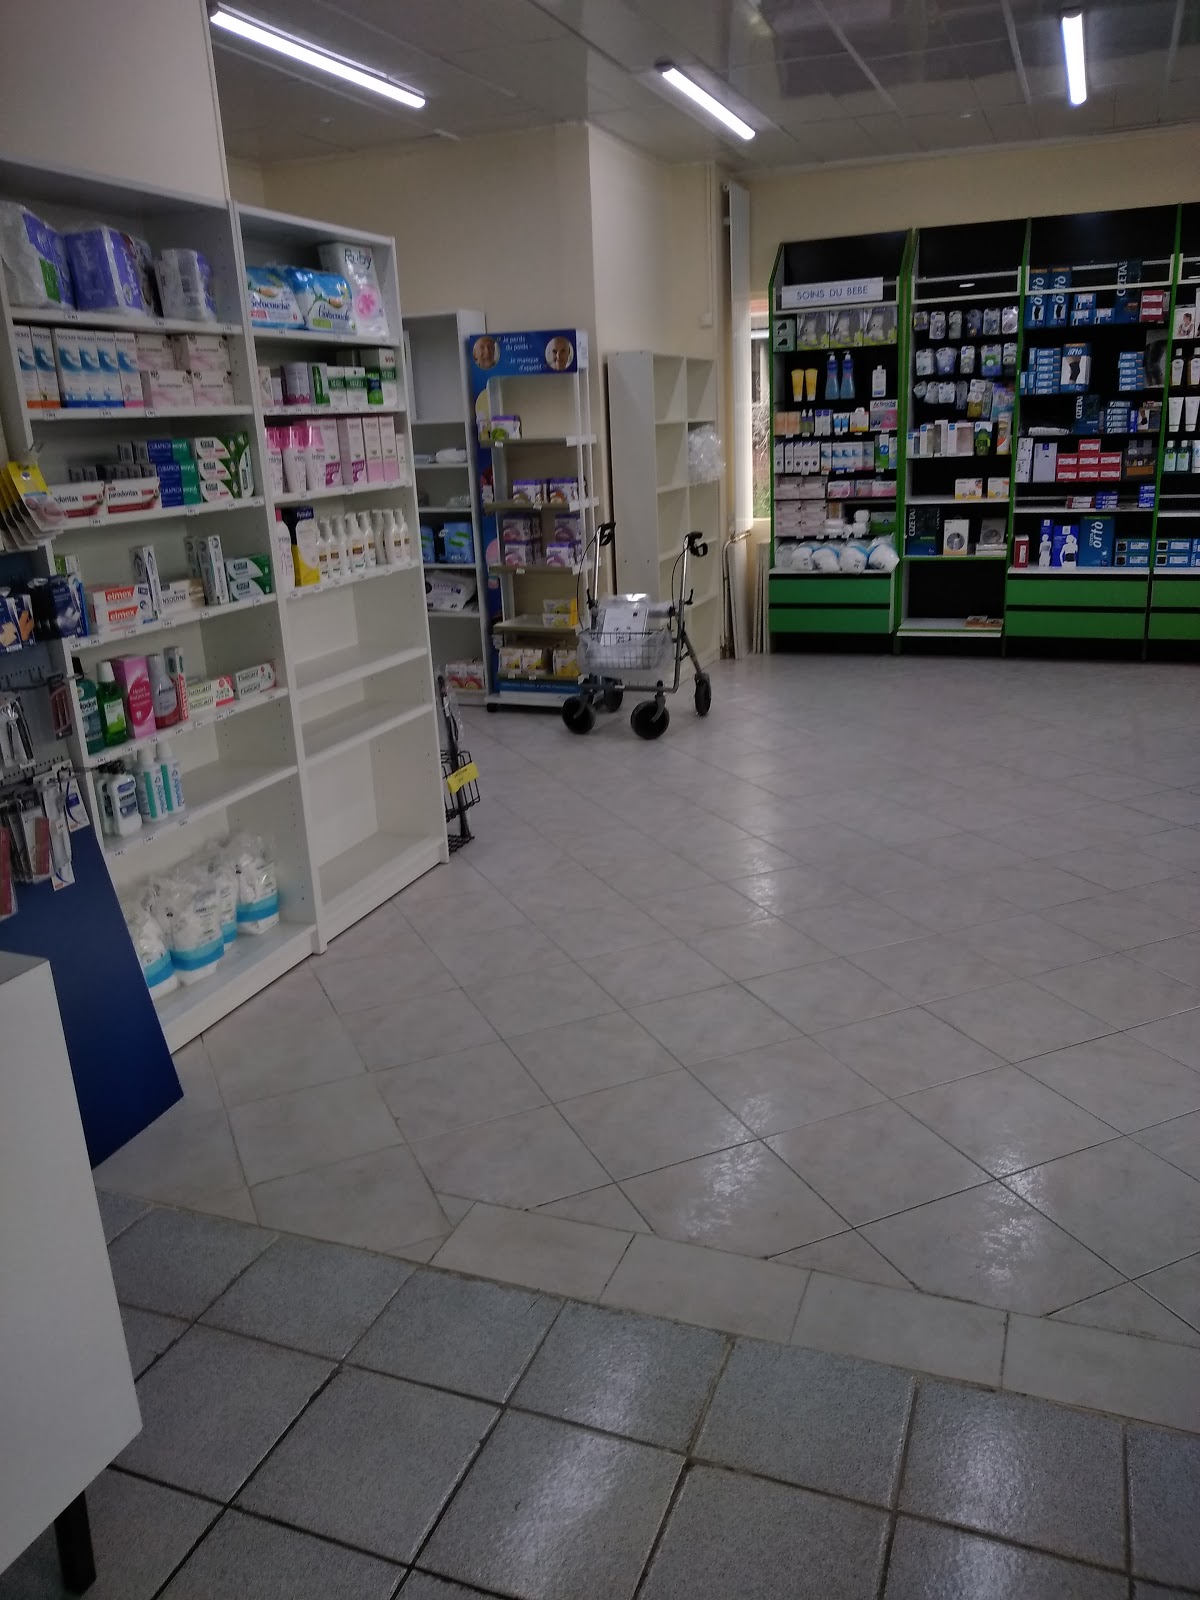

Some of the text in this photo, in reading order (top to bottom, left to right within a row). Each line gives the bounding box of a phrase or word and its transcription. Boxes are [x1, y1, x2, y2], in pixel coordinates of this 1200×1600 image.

[796, 285, 869, 301] SOINS DU BEBE
[108, 489, 139, 500] parodontax
[106, 588, 133, 602] elmex
[110, 608, 136, 621] elmex
